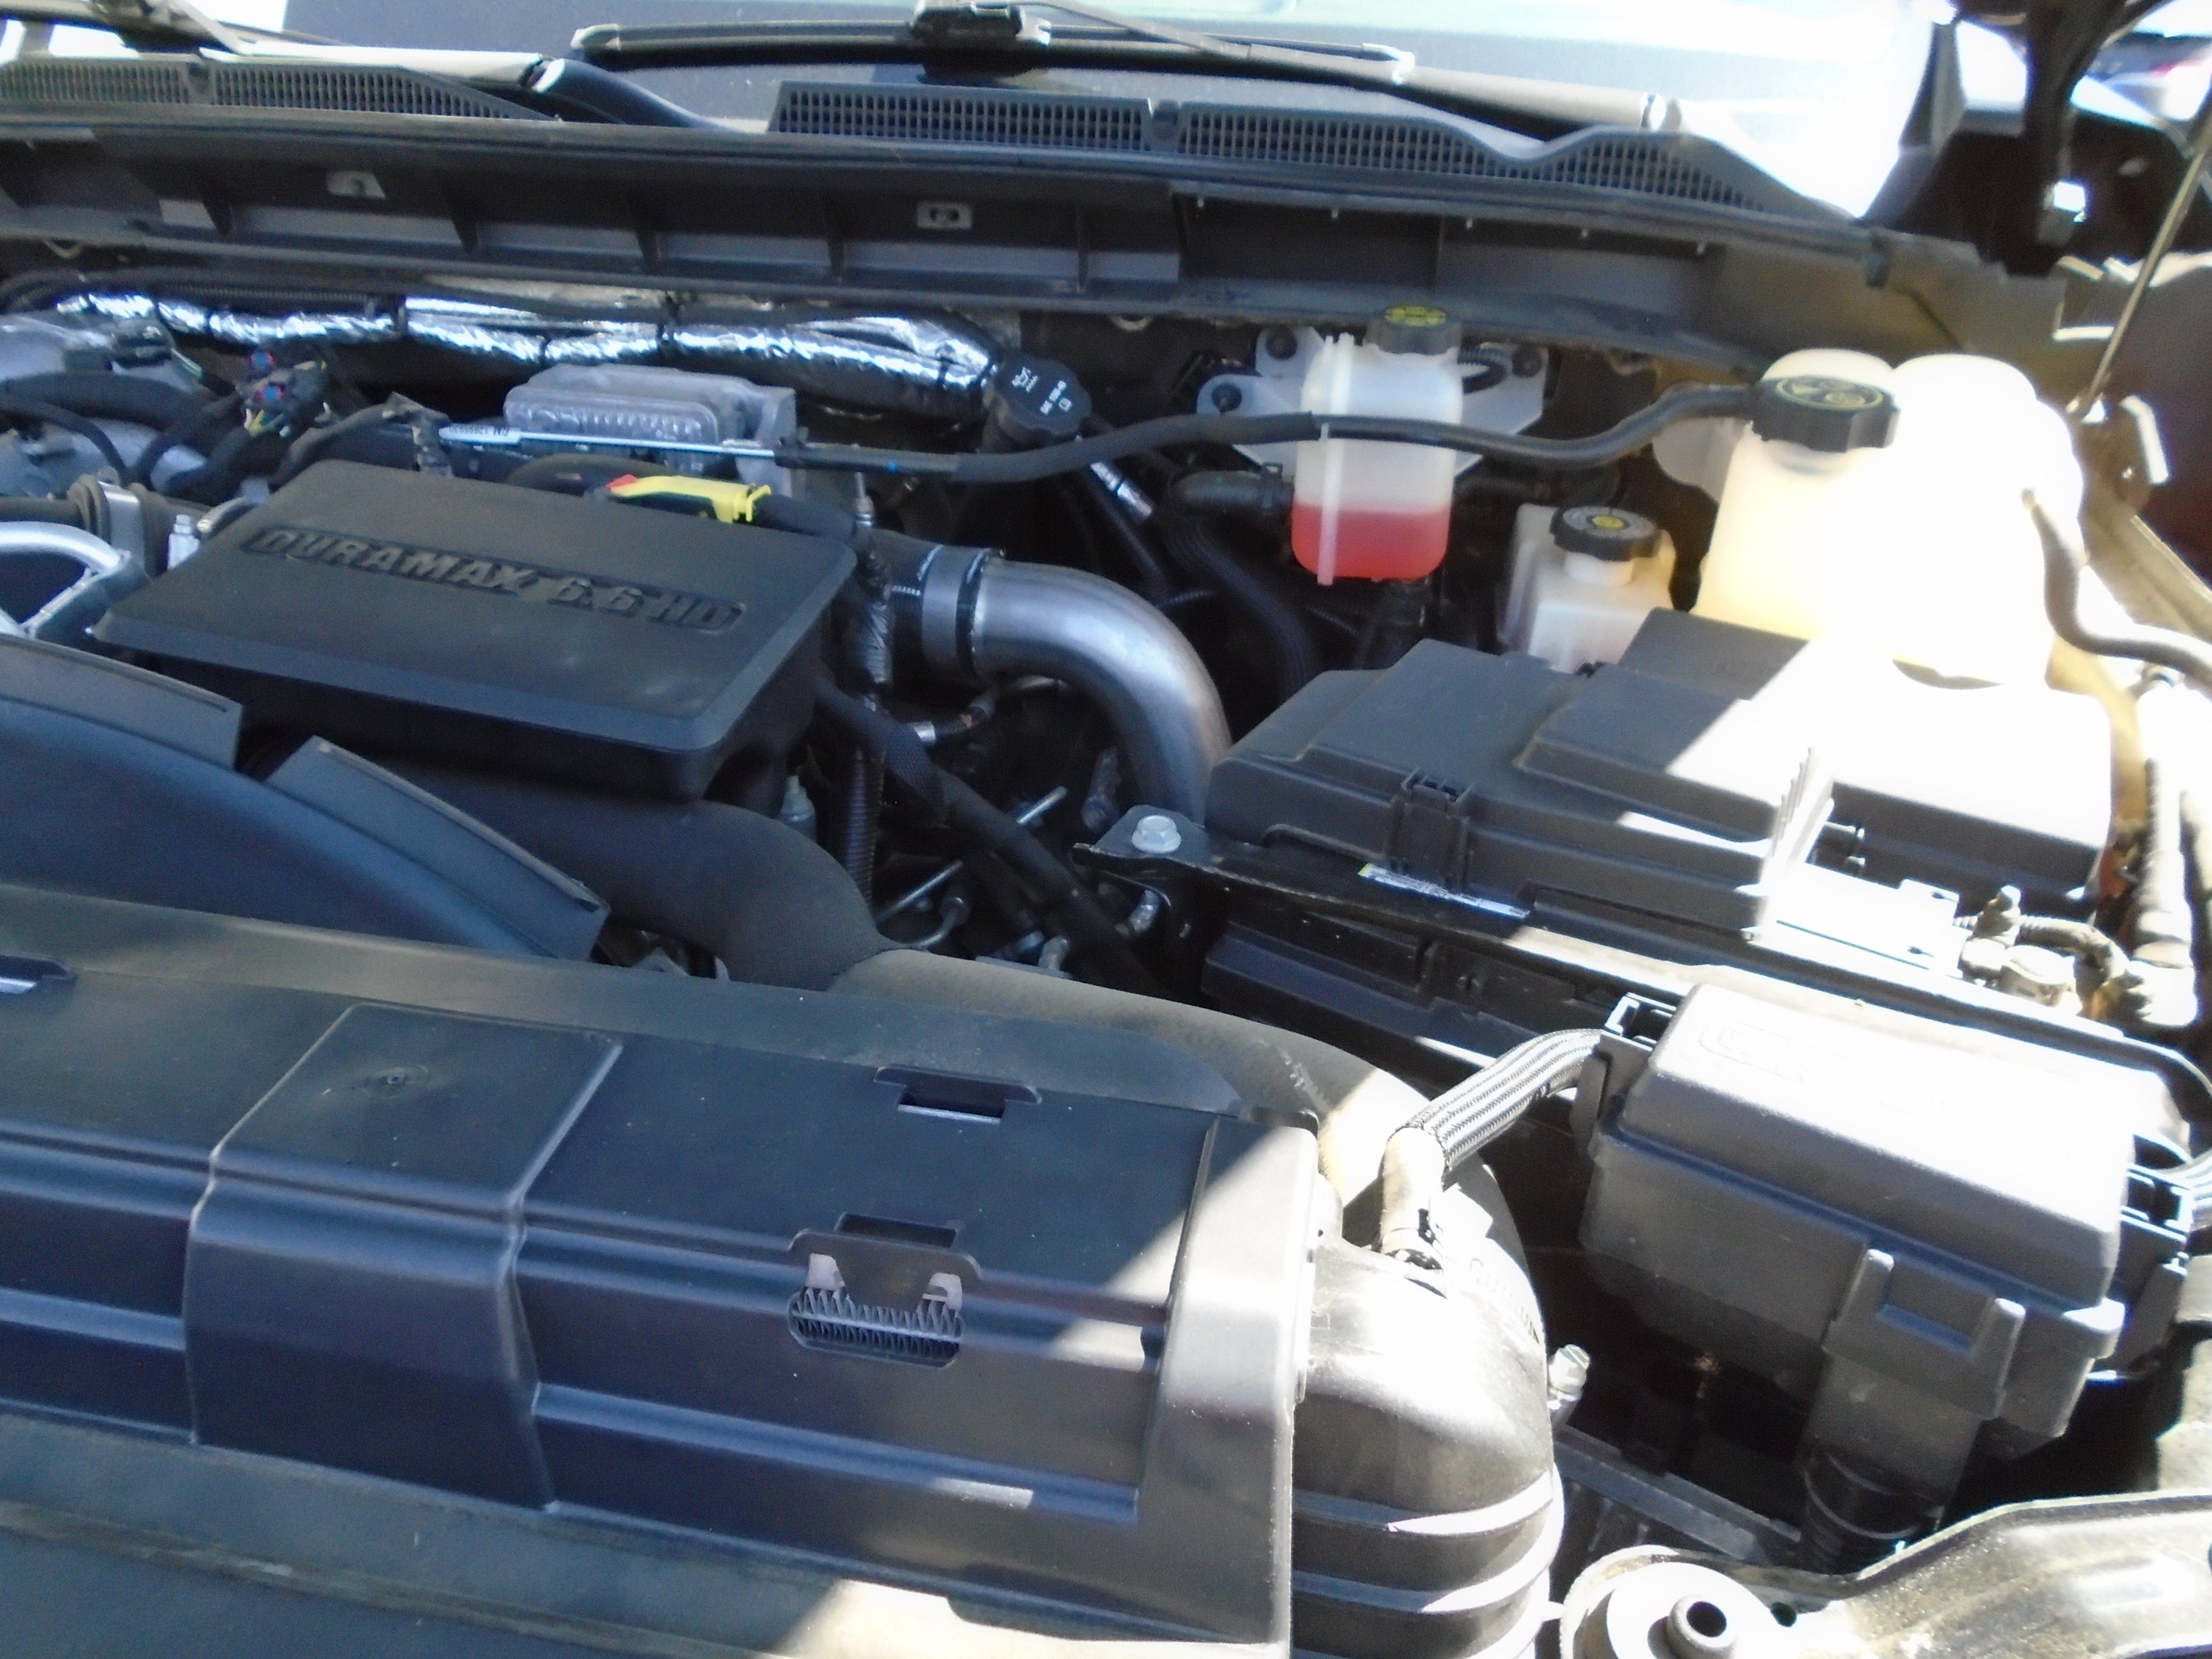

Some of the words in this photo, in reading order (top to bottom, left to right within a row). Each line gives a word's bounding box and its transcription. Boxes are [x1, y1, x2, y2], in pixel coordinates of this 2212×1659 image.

[249, 528, 537, 595] DURAMAX
[549, 576, 644, 617] 6.6
[646, 593, 739, 631] HD
